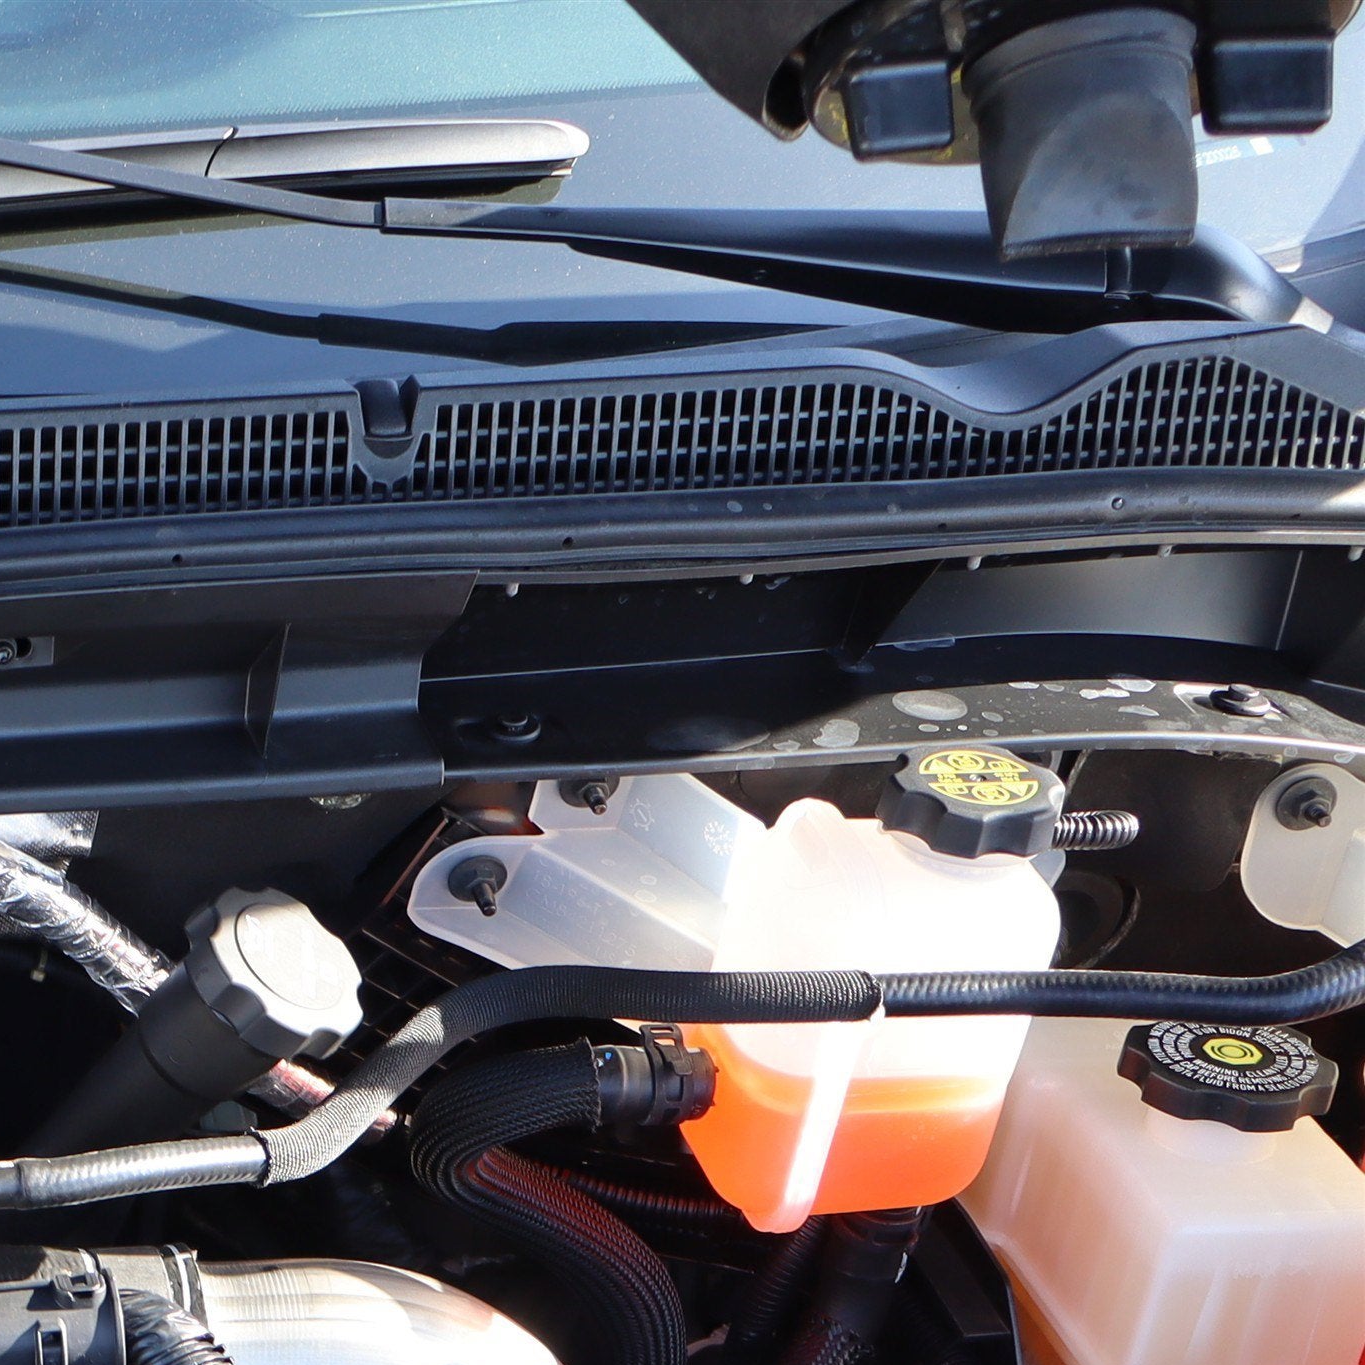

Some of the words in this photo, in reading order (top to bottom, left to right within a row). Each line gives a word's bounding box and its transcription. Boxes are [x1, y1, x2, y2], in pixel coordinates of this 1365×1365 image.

[1219, 1026, 1250, 1037] BIDON
[1179, 1061, 1200, 1071] CAP
[1197, 1069, 1236, 1083] BEFORE
[1193, 1073, 1223, 1086] FLUID
[1226, 1081, 1257, 1091] FROM
